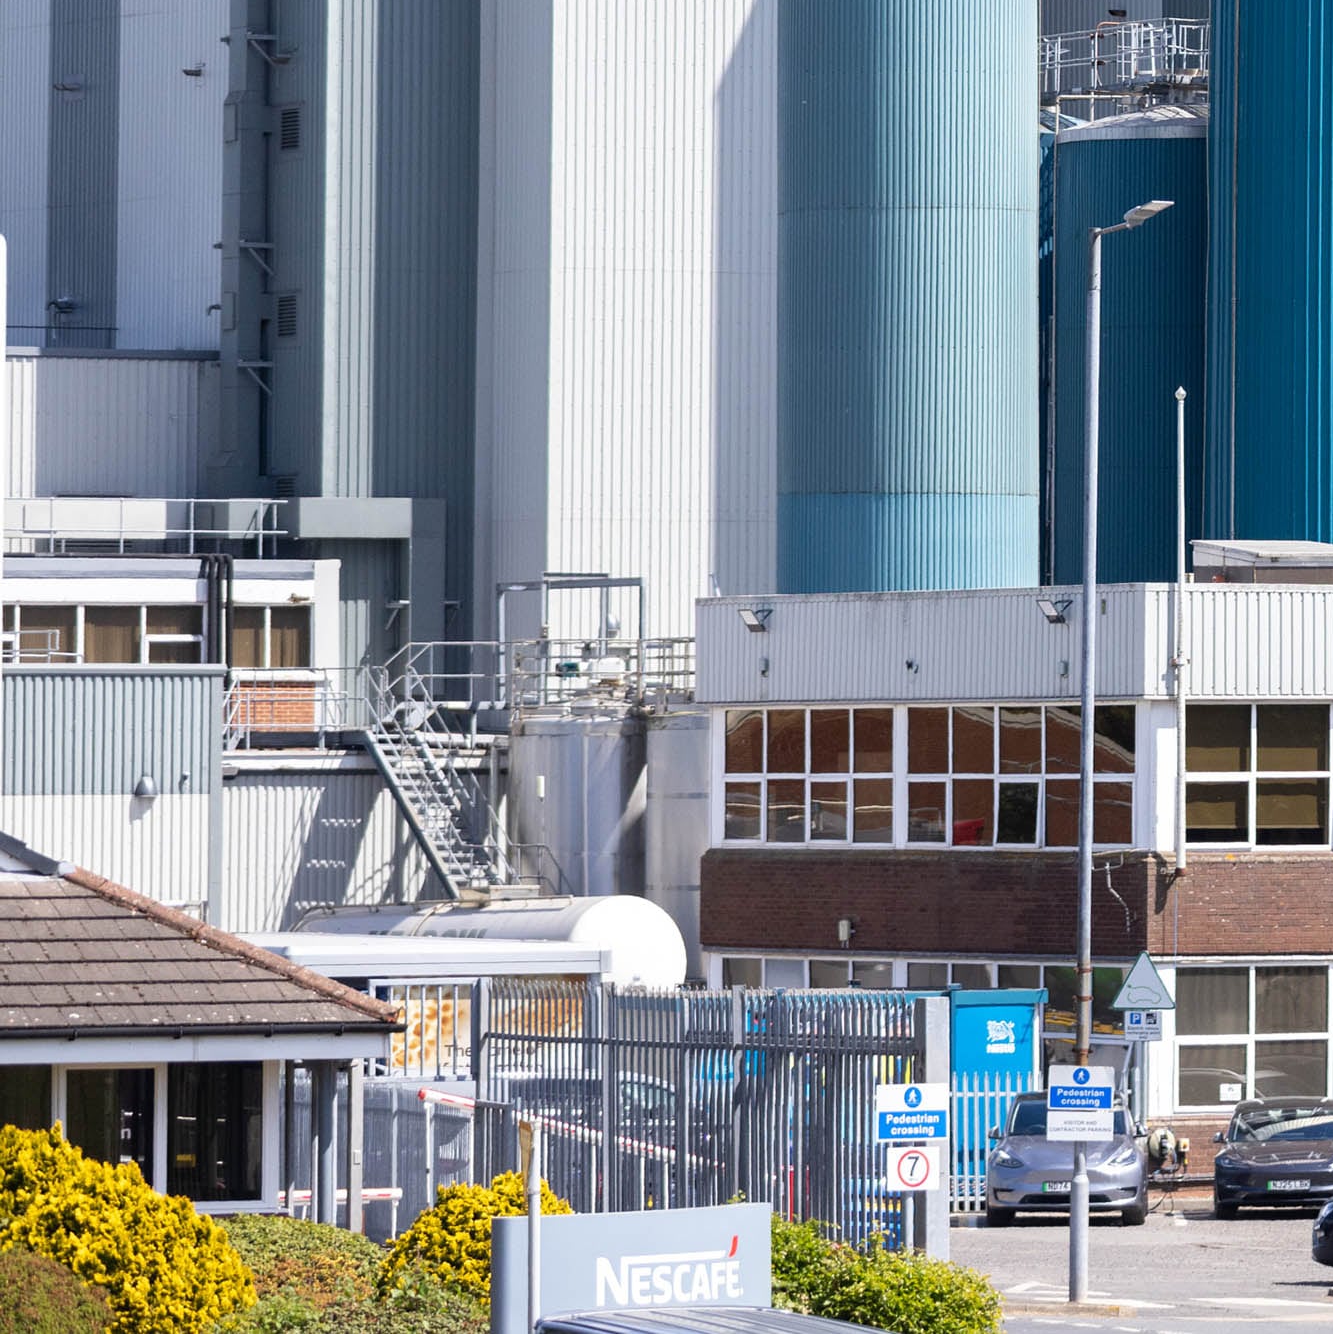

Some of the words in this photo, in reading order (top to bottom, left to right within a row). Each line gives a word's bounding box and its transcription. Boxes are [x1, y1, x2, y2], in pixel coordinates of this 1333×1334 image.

[1056, 1088, 1105, 1097] Pedestrian
[1060, 1098, 1101, 1107] crossing
[886, 1114, 940, 1125] Pedestrian
[890, 1125, 935, 1137] crossing
[907, 1156, 920, 1177] 7
[596, 1235, 741, 1307] NESCAFÉ
